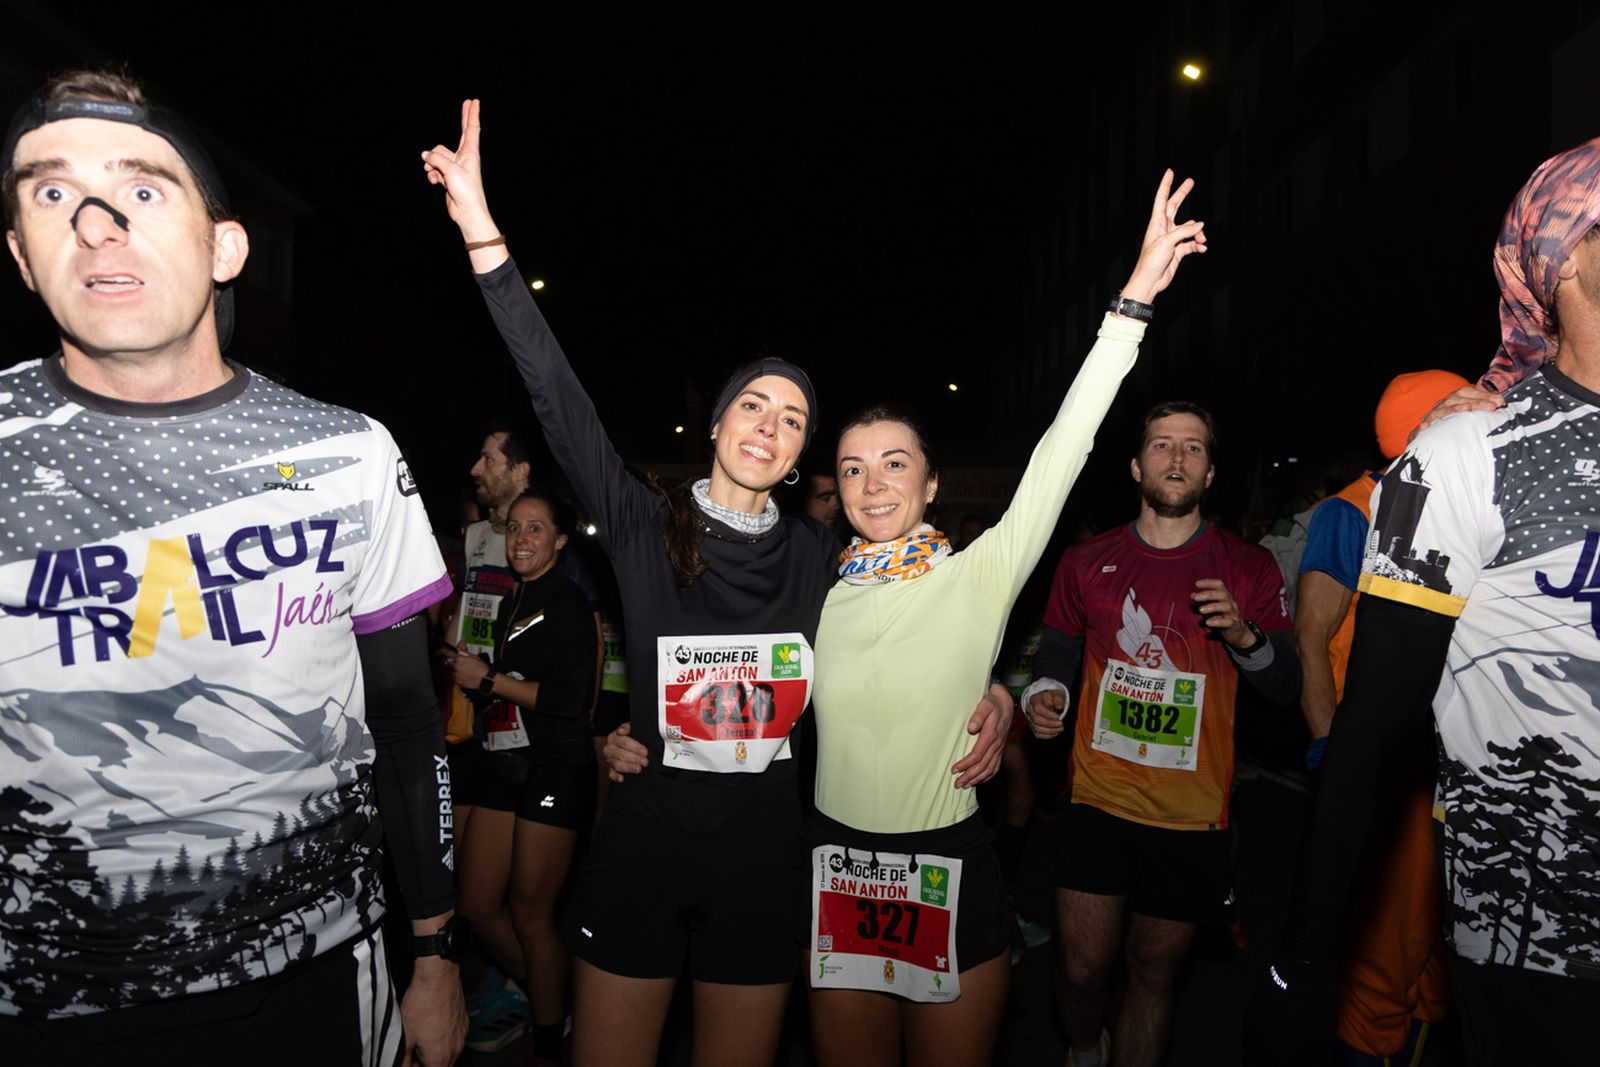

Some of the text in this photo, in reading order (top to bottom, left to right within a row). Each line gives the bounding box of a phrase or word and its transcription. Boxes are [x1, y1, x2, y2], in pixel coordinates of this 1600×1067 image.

[261, 482, 315, 491] SPALL
[693, 652, 739, 664] NOCHE
[741, 651, 758, 663] DE
[1136, 642, 1163, 669] 43
[676, 668, 706, 683] SAN
[709, 662, 758, 681] ANTÓN
[1124, 674, 1153, 690] NOCHE
[1153, 681, 1166, 691] DE
[1110, 682, 1130, 696] SAN
[702, 681, 776, 725] 328
[1118, 699, 1180, 735] 1382
[433, 754, 454, 845] TERREX
[846, 864, 887, 881] NOCHE
[890, 869, 907, 882] DE
[830, 877, 908, 900] SAN ANTÓN
[856, 900, 921, 947] 327
